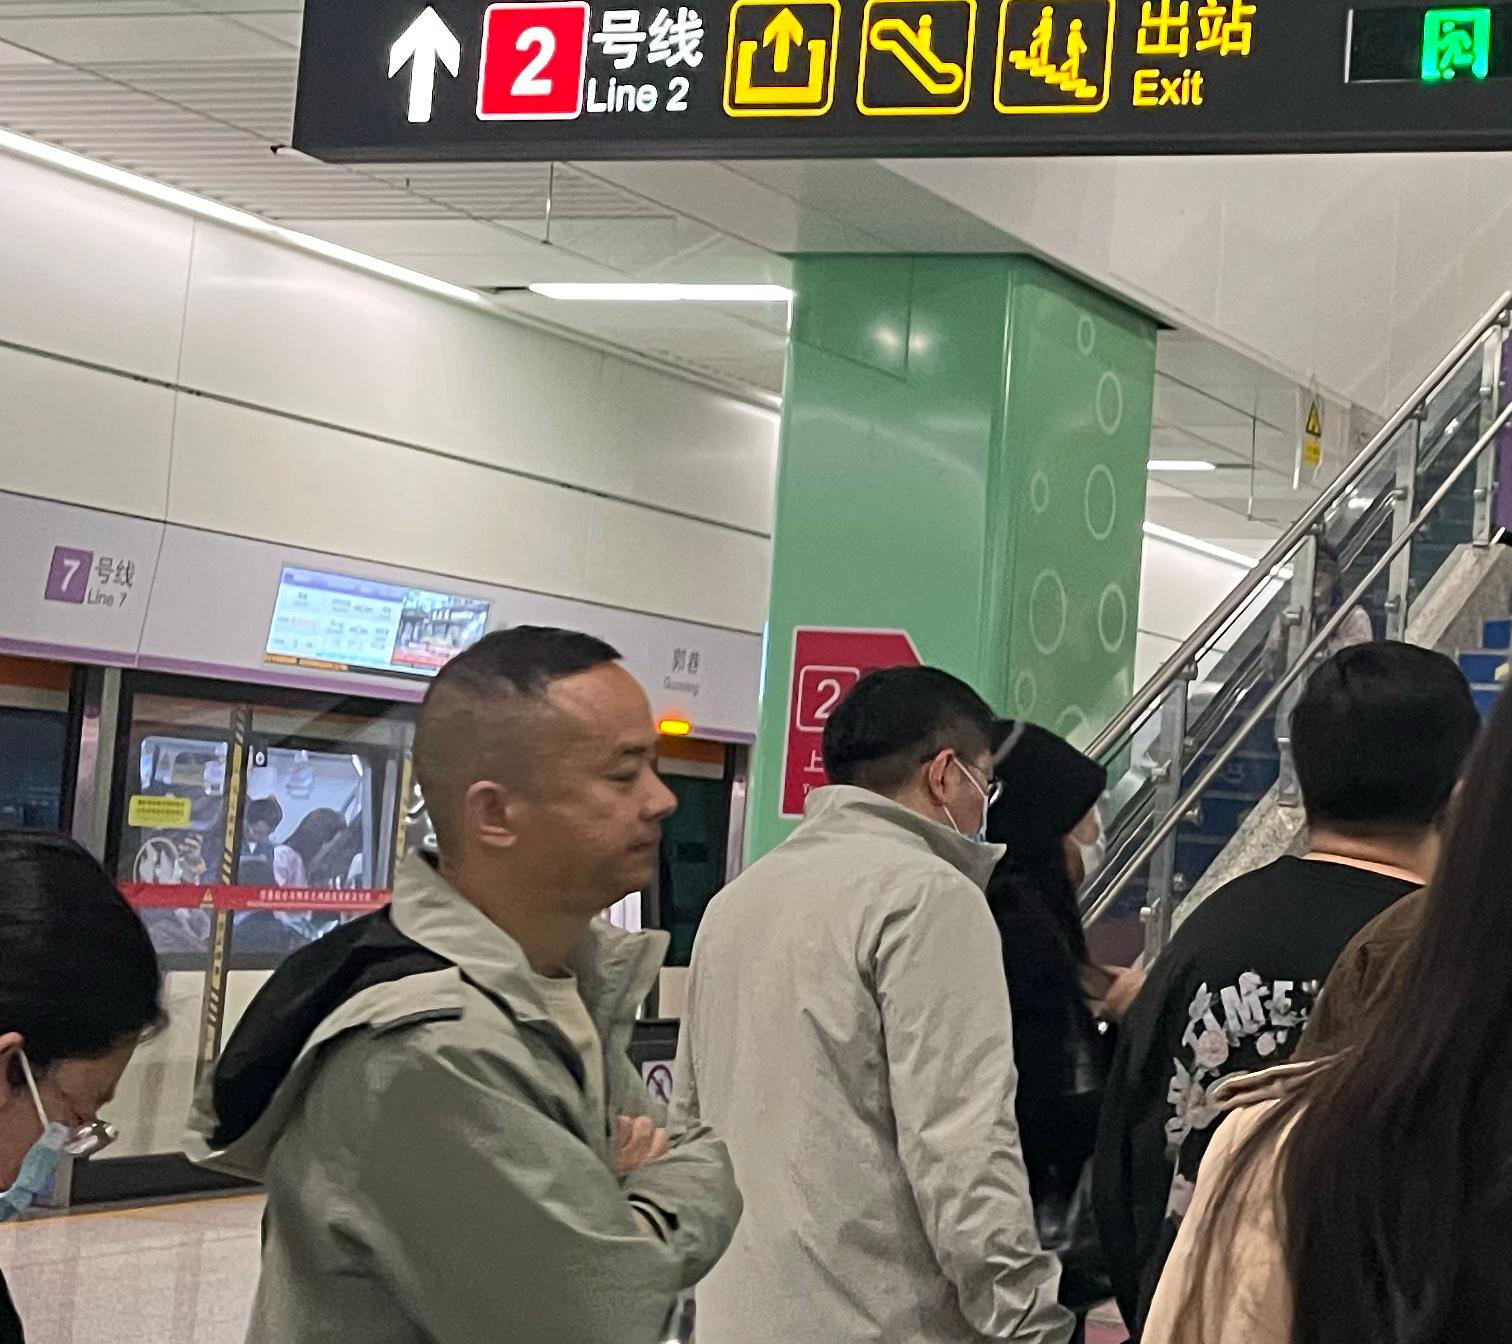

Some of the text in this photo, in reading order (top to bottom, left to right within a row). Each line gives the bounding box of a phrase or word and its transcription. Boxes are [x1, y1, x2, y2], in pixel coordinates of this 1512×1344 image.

[510, 6, 705, 96] 2 号线
[586, 76, 690, 112] Line 2
[1132, 68, 1204, 106] Exit
[61, 556, 135, 593] 7 号线
[87, 587, 115, 607] Line
